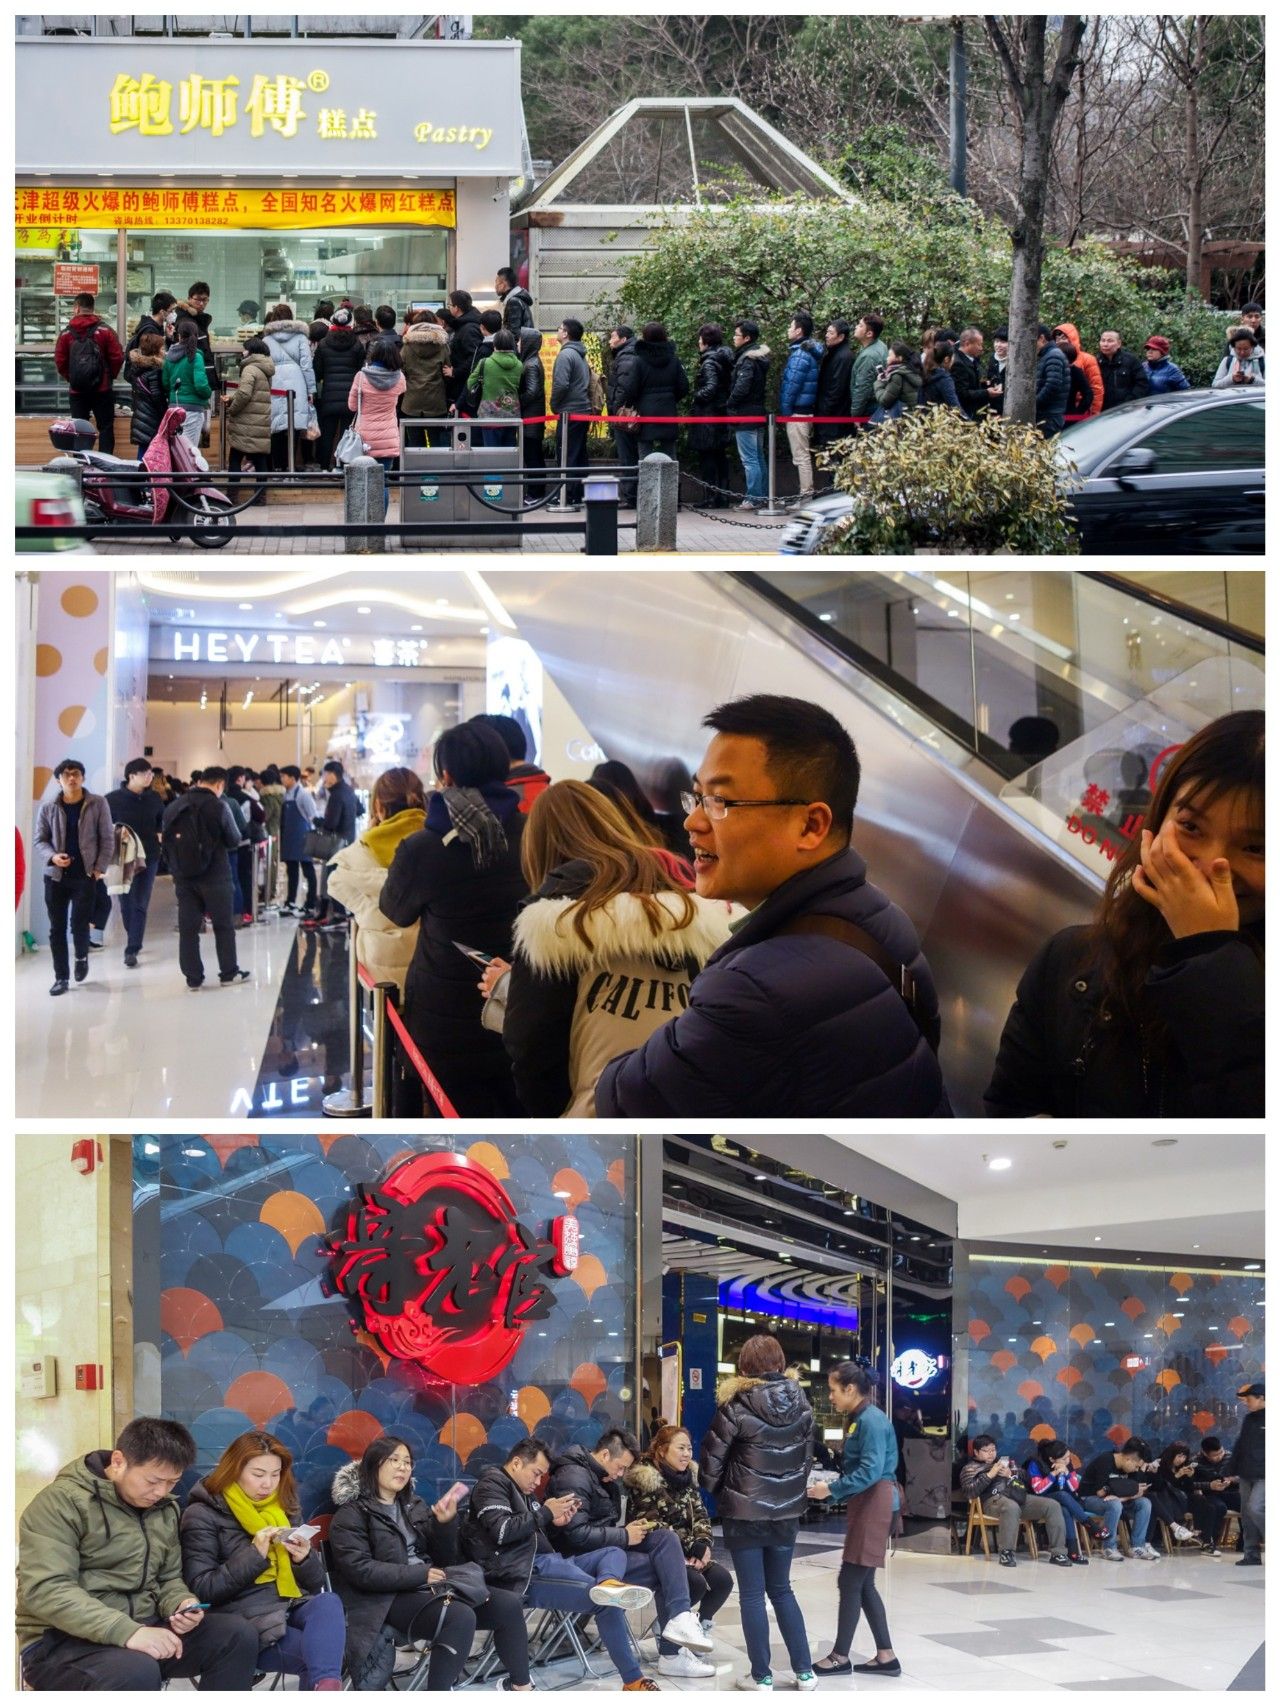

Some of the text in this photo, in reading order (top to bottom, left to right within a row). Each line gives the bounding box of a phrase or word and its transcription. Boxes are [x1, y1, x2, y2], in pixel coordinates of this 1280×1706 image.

[109, 72, 306, 138] 鲍师傅
[317, 107, 378, 140] 糕点
[413, 121, 493, 150] Pastry
[15, 190, 455, 214] 津超级火爆的鲍师傅糕点，全国知名火爆网红糕点
[173, 631, 345, 665] HEYTEA
